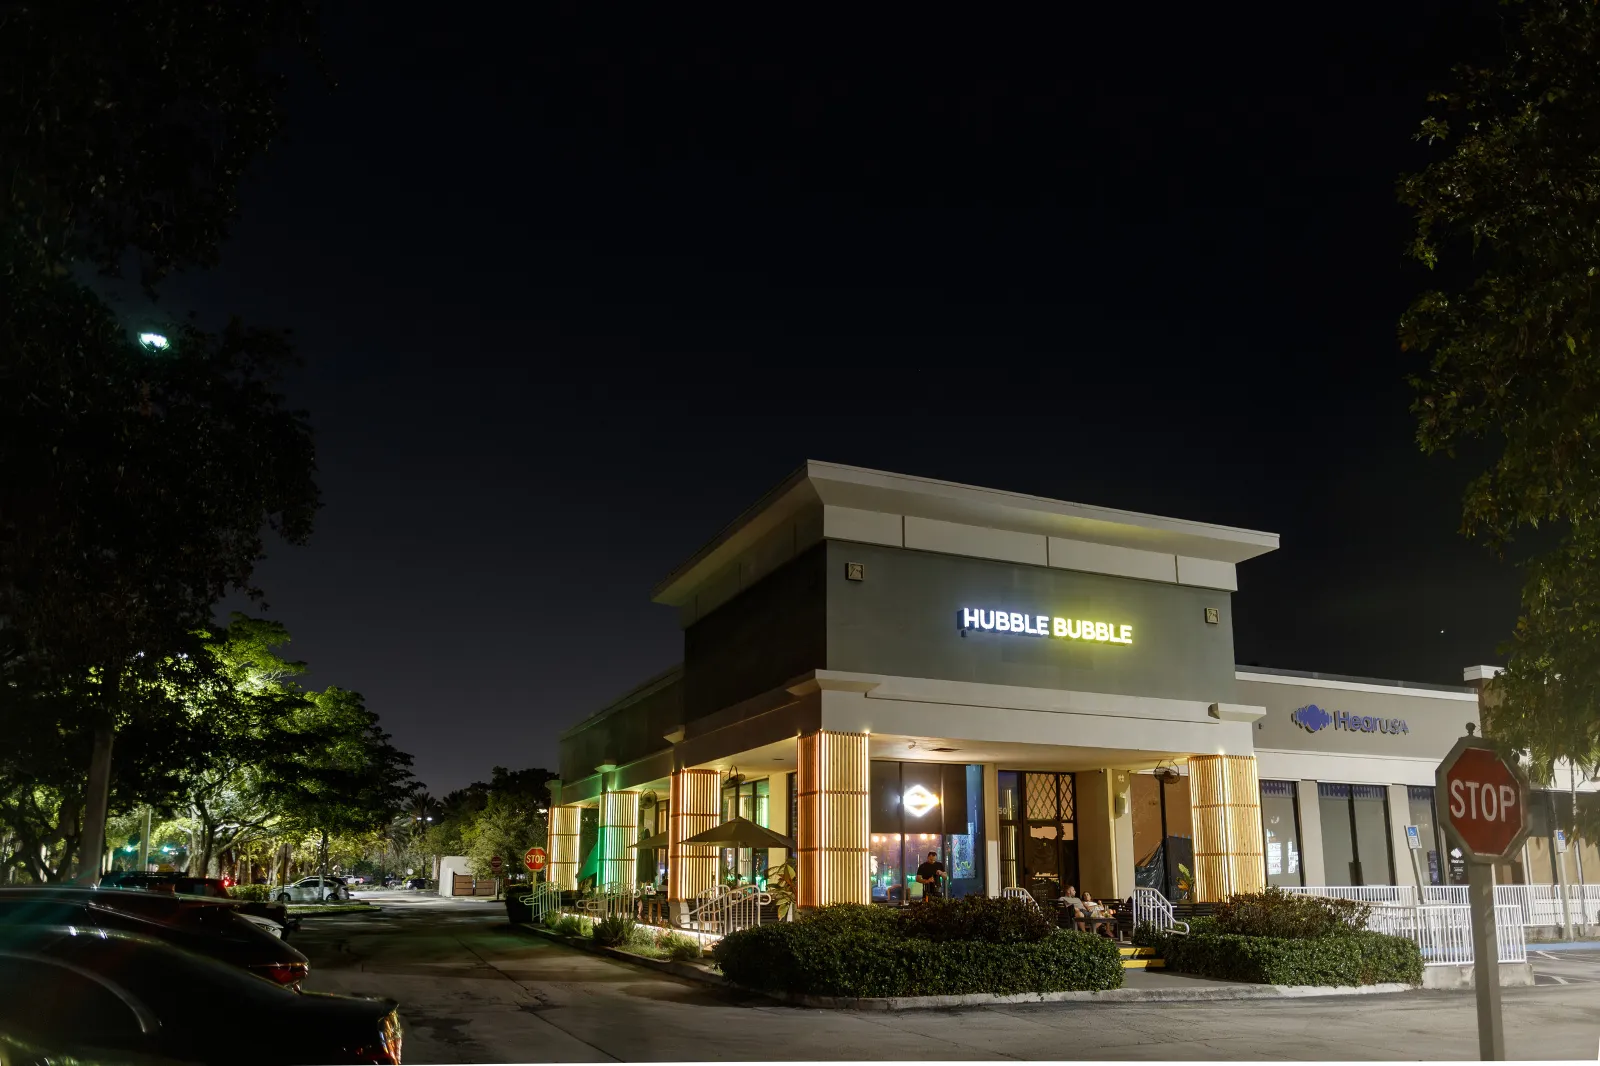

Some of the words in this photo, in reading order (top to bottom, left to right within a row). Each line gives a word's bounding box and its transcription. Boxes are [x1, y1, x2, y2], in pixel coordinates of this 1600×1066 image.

[963, 607, 1050, 636] HUBBLE
[1053, 617, 1133, 644] BUBBLE
[1450, 778, 1516, 822] STOP
[526, 854, 546, 864] STOP
